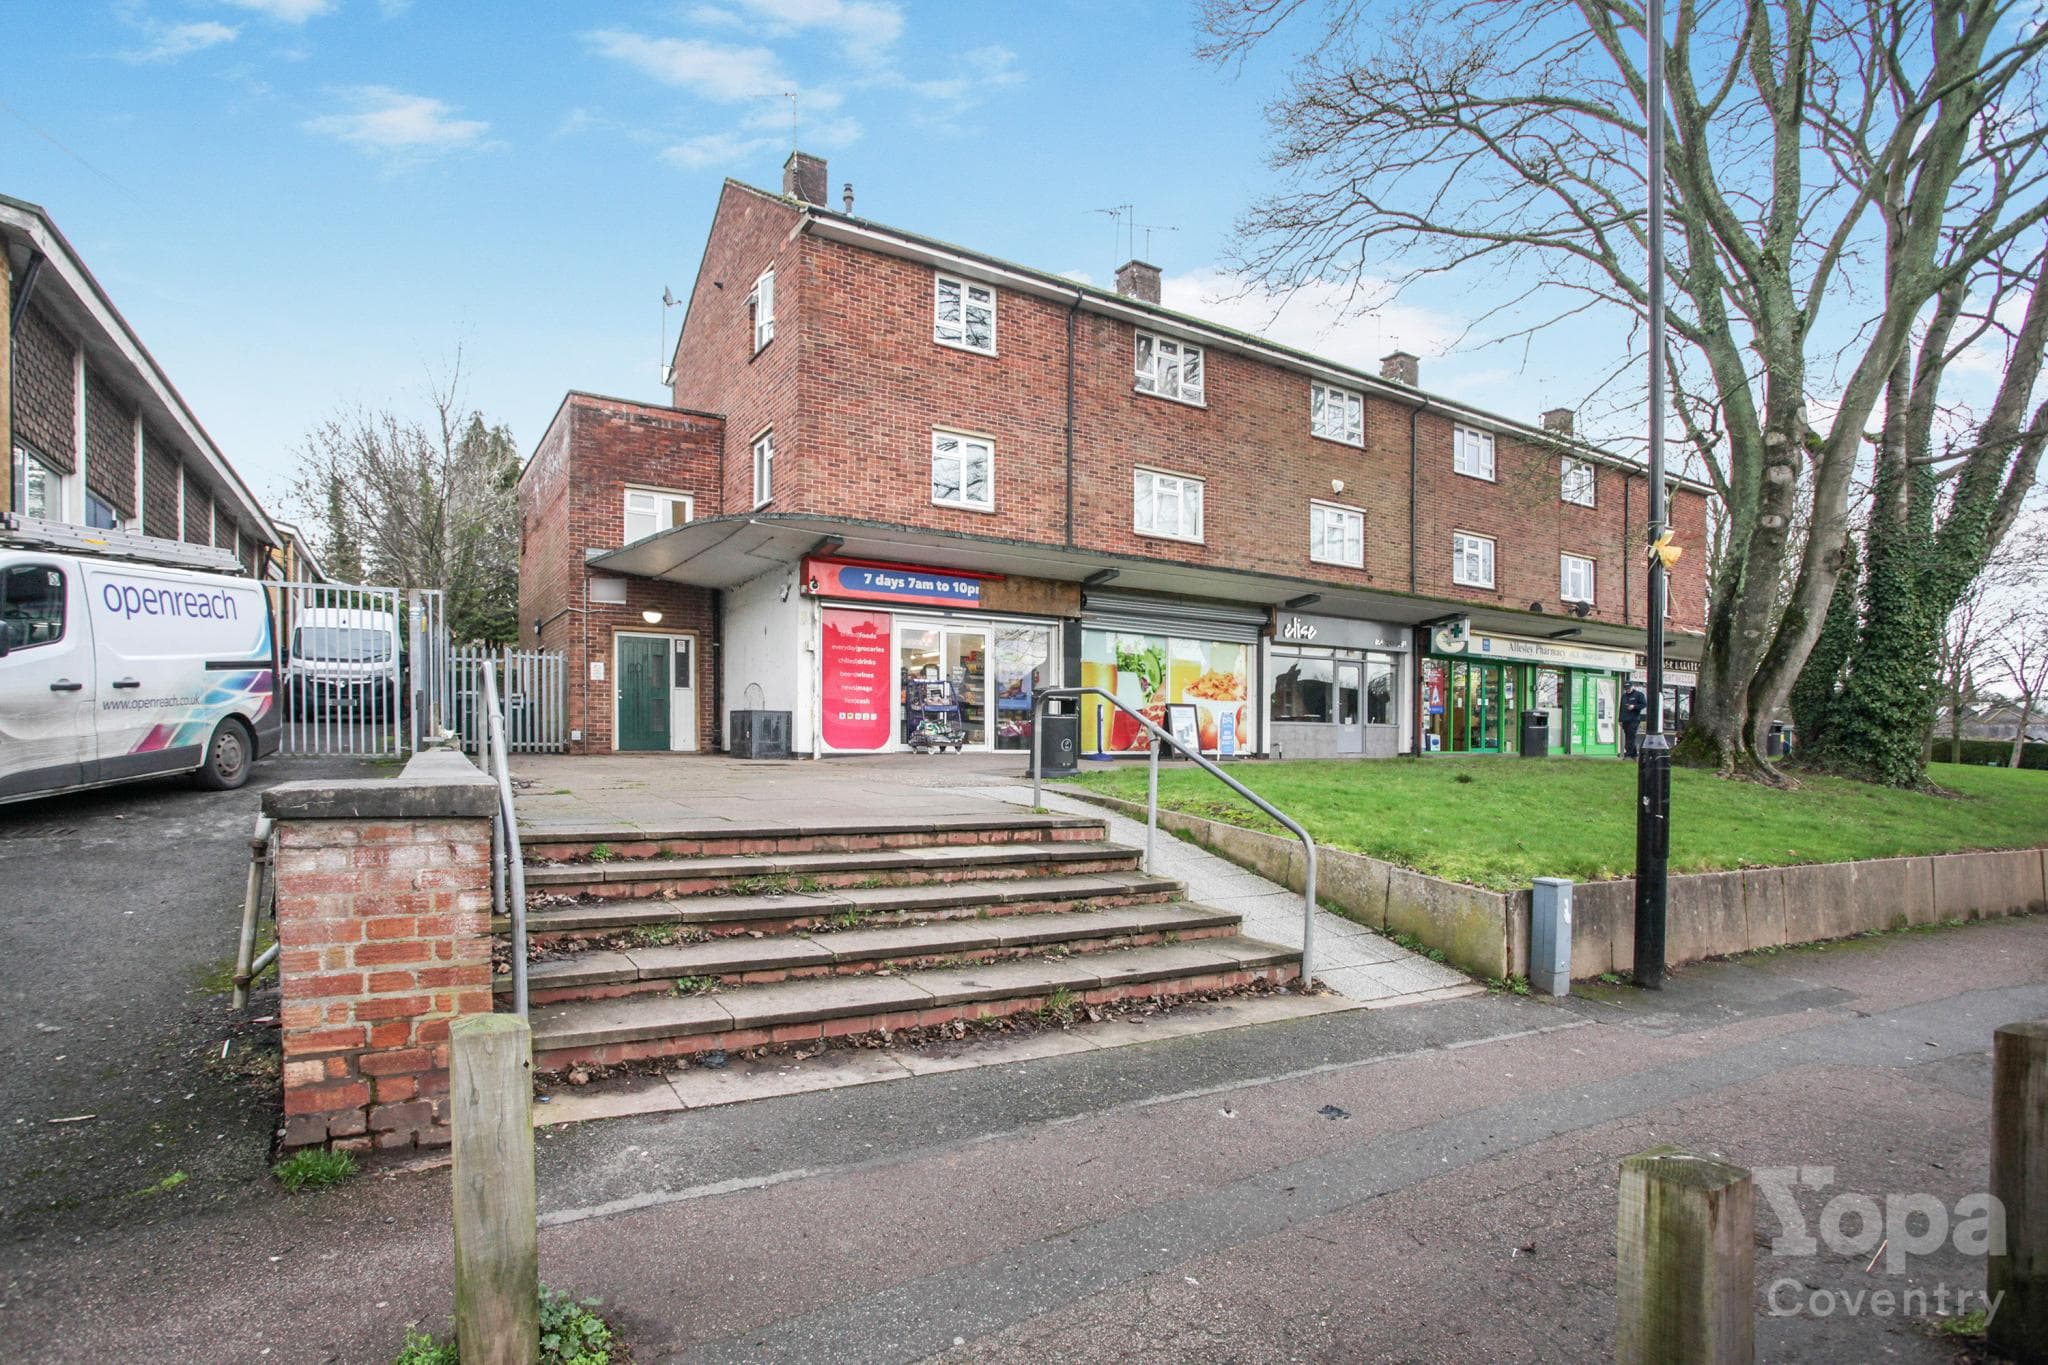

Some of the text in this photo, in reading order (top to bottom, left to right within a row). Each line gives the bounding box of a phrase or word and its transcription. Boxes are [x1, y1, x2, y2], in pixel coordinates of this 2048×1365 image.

[864, 573, 872, 584] 7
[875, 574, 904, 590] days
[908, 578, 934, 591] 7am
[936, 580, 950, 592] to
[103, 583, 238, 620] openreach
[1284, 617, 1317, 640] elise
[1508, 642, 1533, 656] Allesley
[1535, 645, 1566, 659] Pharmacy
[102, 694, 201, 711] www.openreach.co.uk
